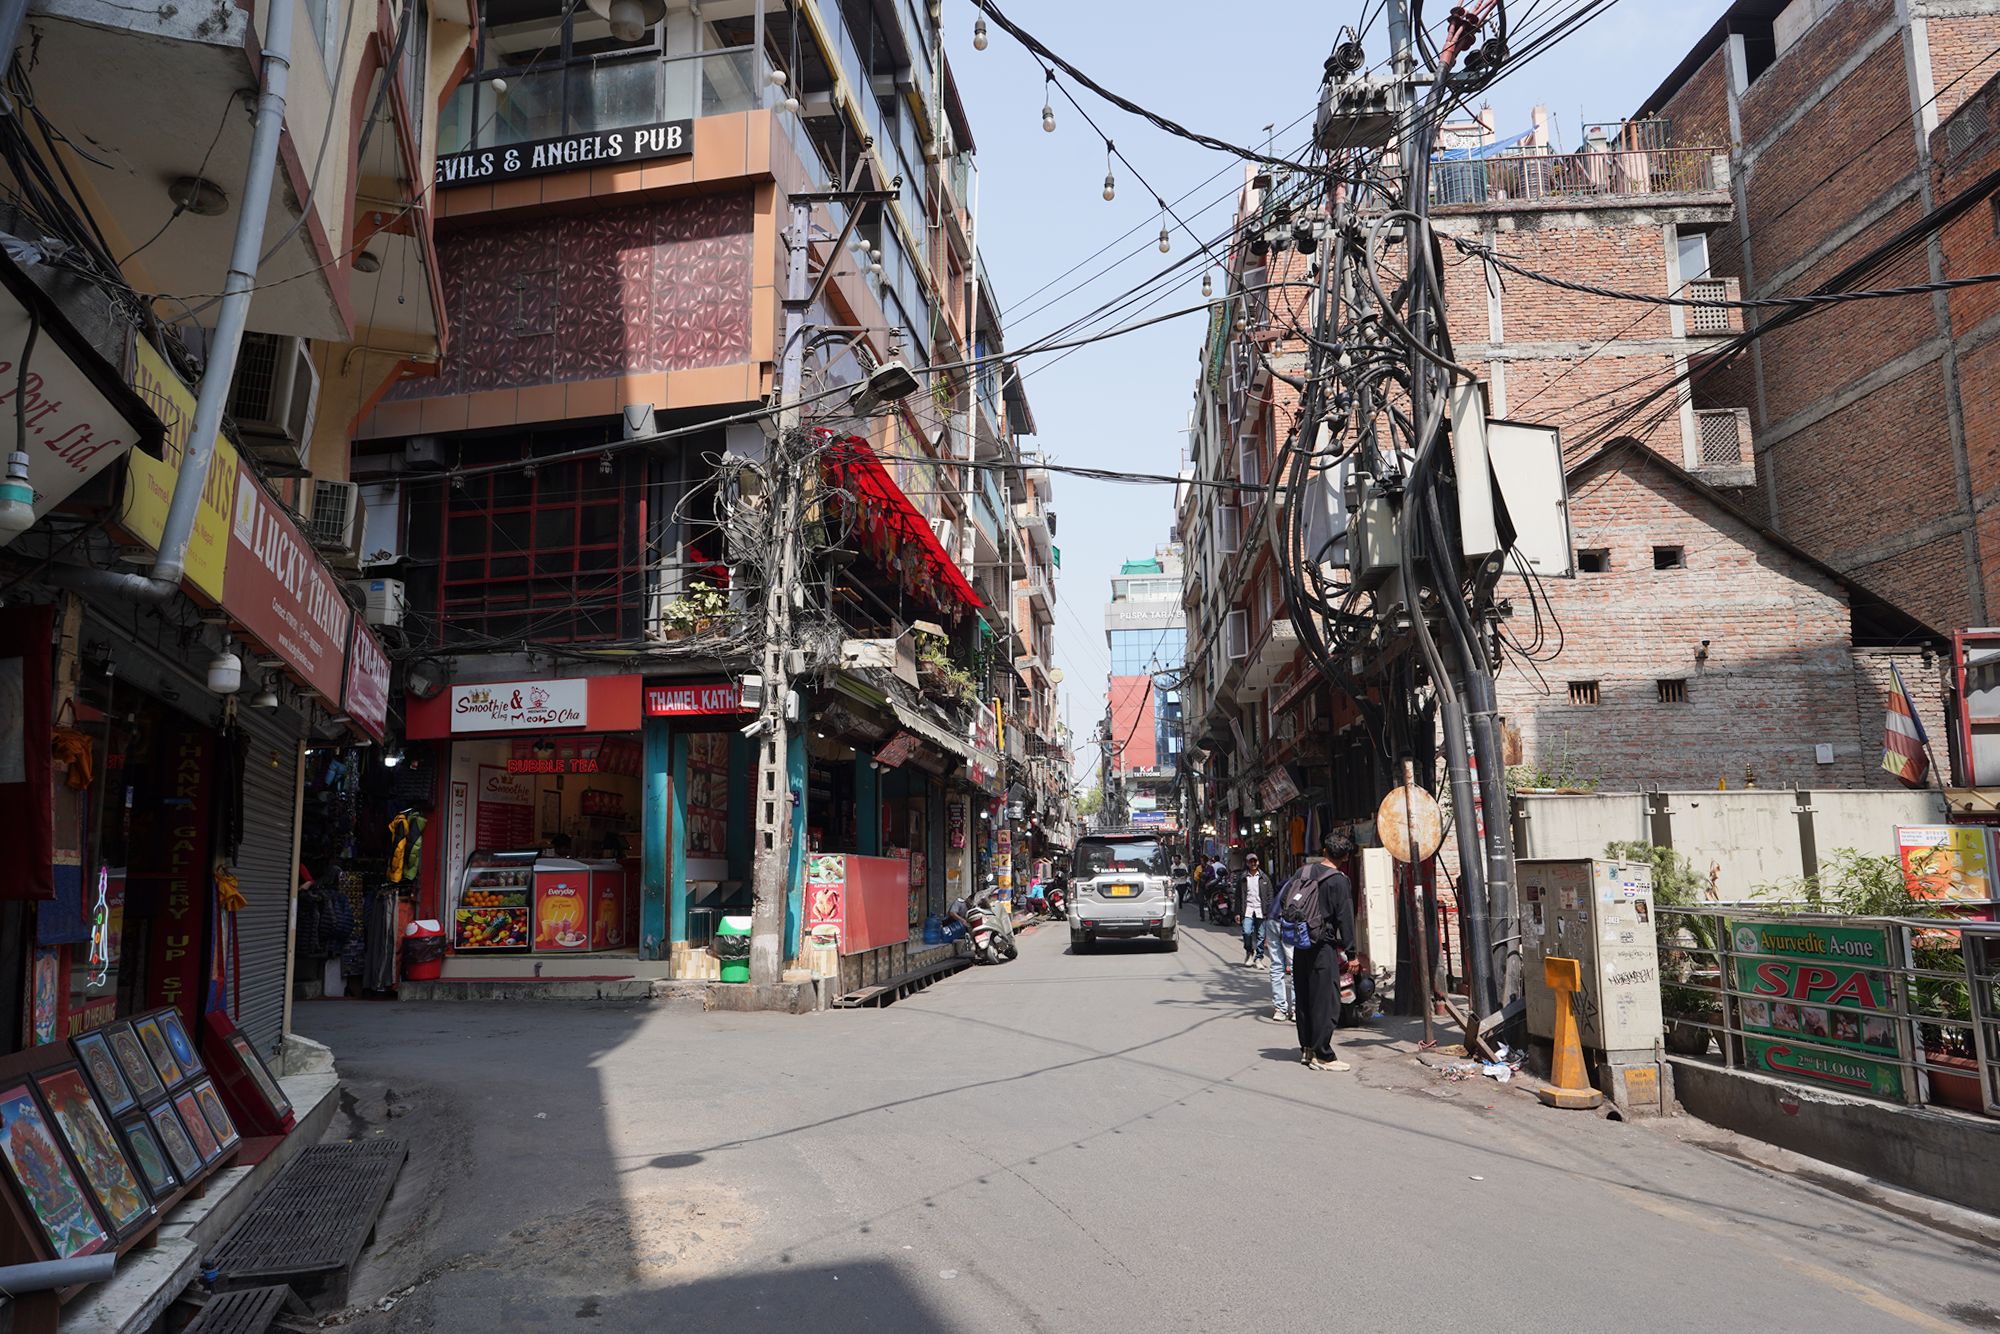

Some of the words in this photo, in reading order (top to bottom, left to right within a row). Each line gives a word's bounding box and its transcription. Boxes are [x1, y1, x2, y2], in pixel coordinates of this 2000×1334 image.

[436, 153, 494, 182] EVILS
[504, 149, 521, 171] &
[531, 133, 623, 169] ANGELS
[634, 125, 683, 154] PUB
[44, 423, 121, 473] Ltd.
[254, 502, 308, 603] LUCKY
[307, 567, 346, 656] THANKA
[1120, 611, 1148, 619] PUSPA
[456, 696, 509, 713] Smoothie
[510, 689, 523, 710] &
[649, 690, 699, 711] THAMEL
[701, 689, 739, 710] KATHI
[491, 710, 508, 721] King
[558, 708, 580, 723] Cha
[507, 759, 565, 773] BUBBLE
[569, 758, 599, 773] TEA
[486, 776, 530, 797] Smoothie
[548, 888, 576, 896] Everyday
[165, 935, 189, 961] UP
[1760, 930, 1826, 955] Ayurvedic
[1830, 935, 1874, 957] A-one
[1753, 962, 1878, 1009] SPA
[1815, 1058, 1868, 1079] FLOOR
